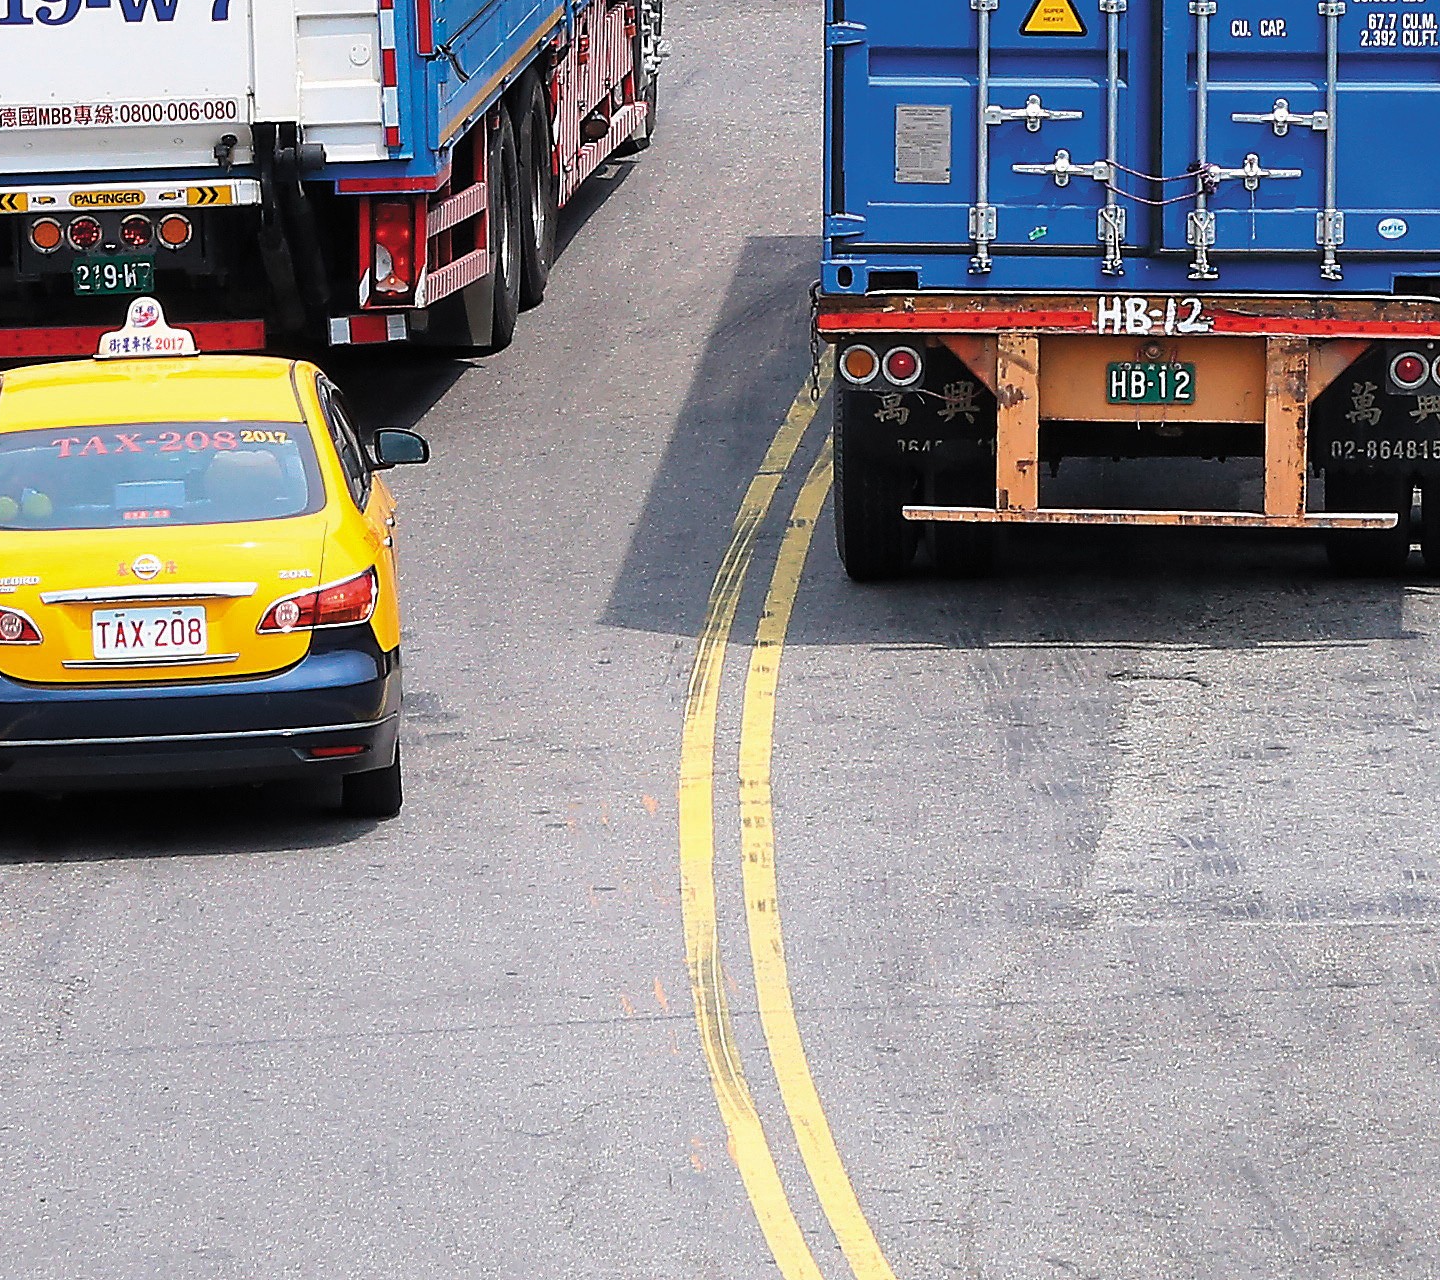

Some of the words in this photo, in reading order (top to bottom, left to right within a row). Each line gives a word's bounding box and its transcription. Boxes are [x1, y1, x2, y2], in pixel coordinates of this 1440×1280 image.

[1232, 20, 1252, 36] CU.
[1261, 20, 1286, 37] CAP.
[1368, 13, 1398, 30] 67.7
[1403, 13, 1438, 30] CU.M.
[1360, 30, 1398, 47] 2.392
[1403, 29, 1439, 47] CU.FT.
[74, 192, 140, 204] PALFINGER
[1097, 297, 1211, 334] HB-12
[155, 337, 185, 350] 2017
[1110, 370, 1192, 401] HB-12
[51, 429, 238, 458] TAX-208
[240, 429, 288, 444] 2017
[97, 618, 201, 649] TAX-208
